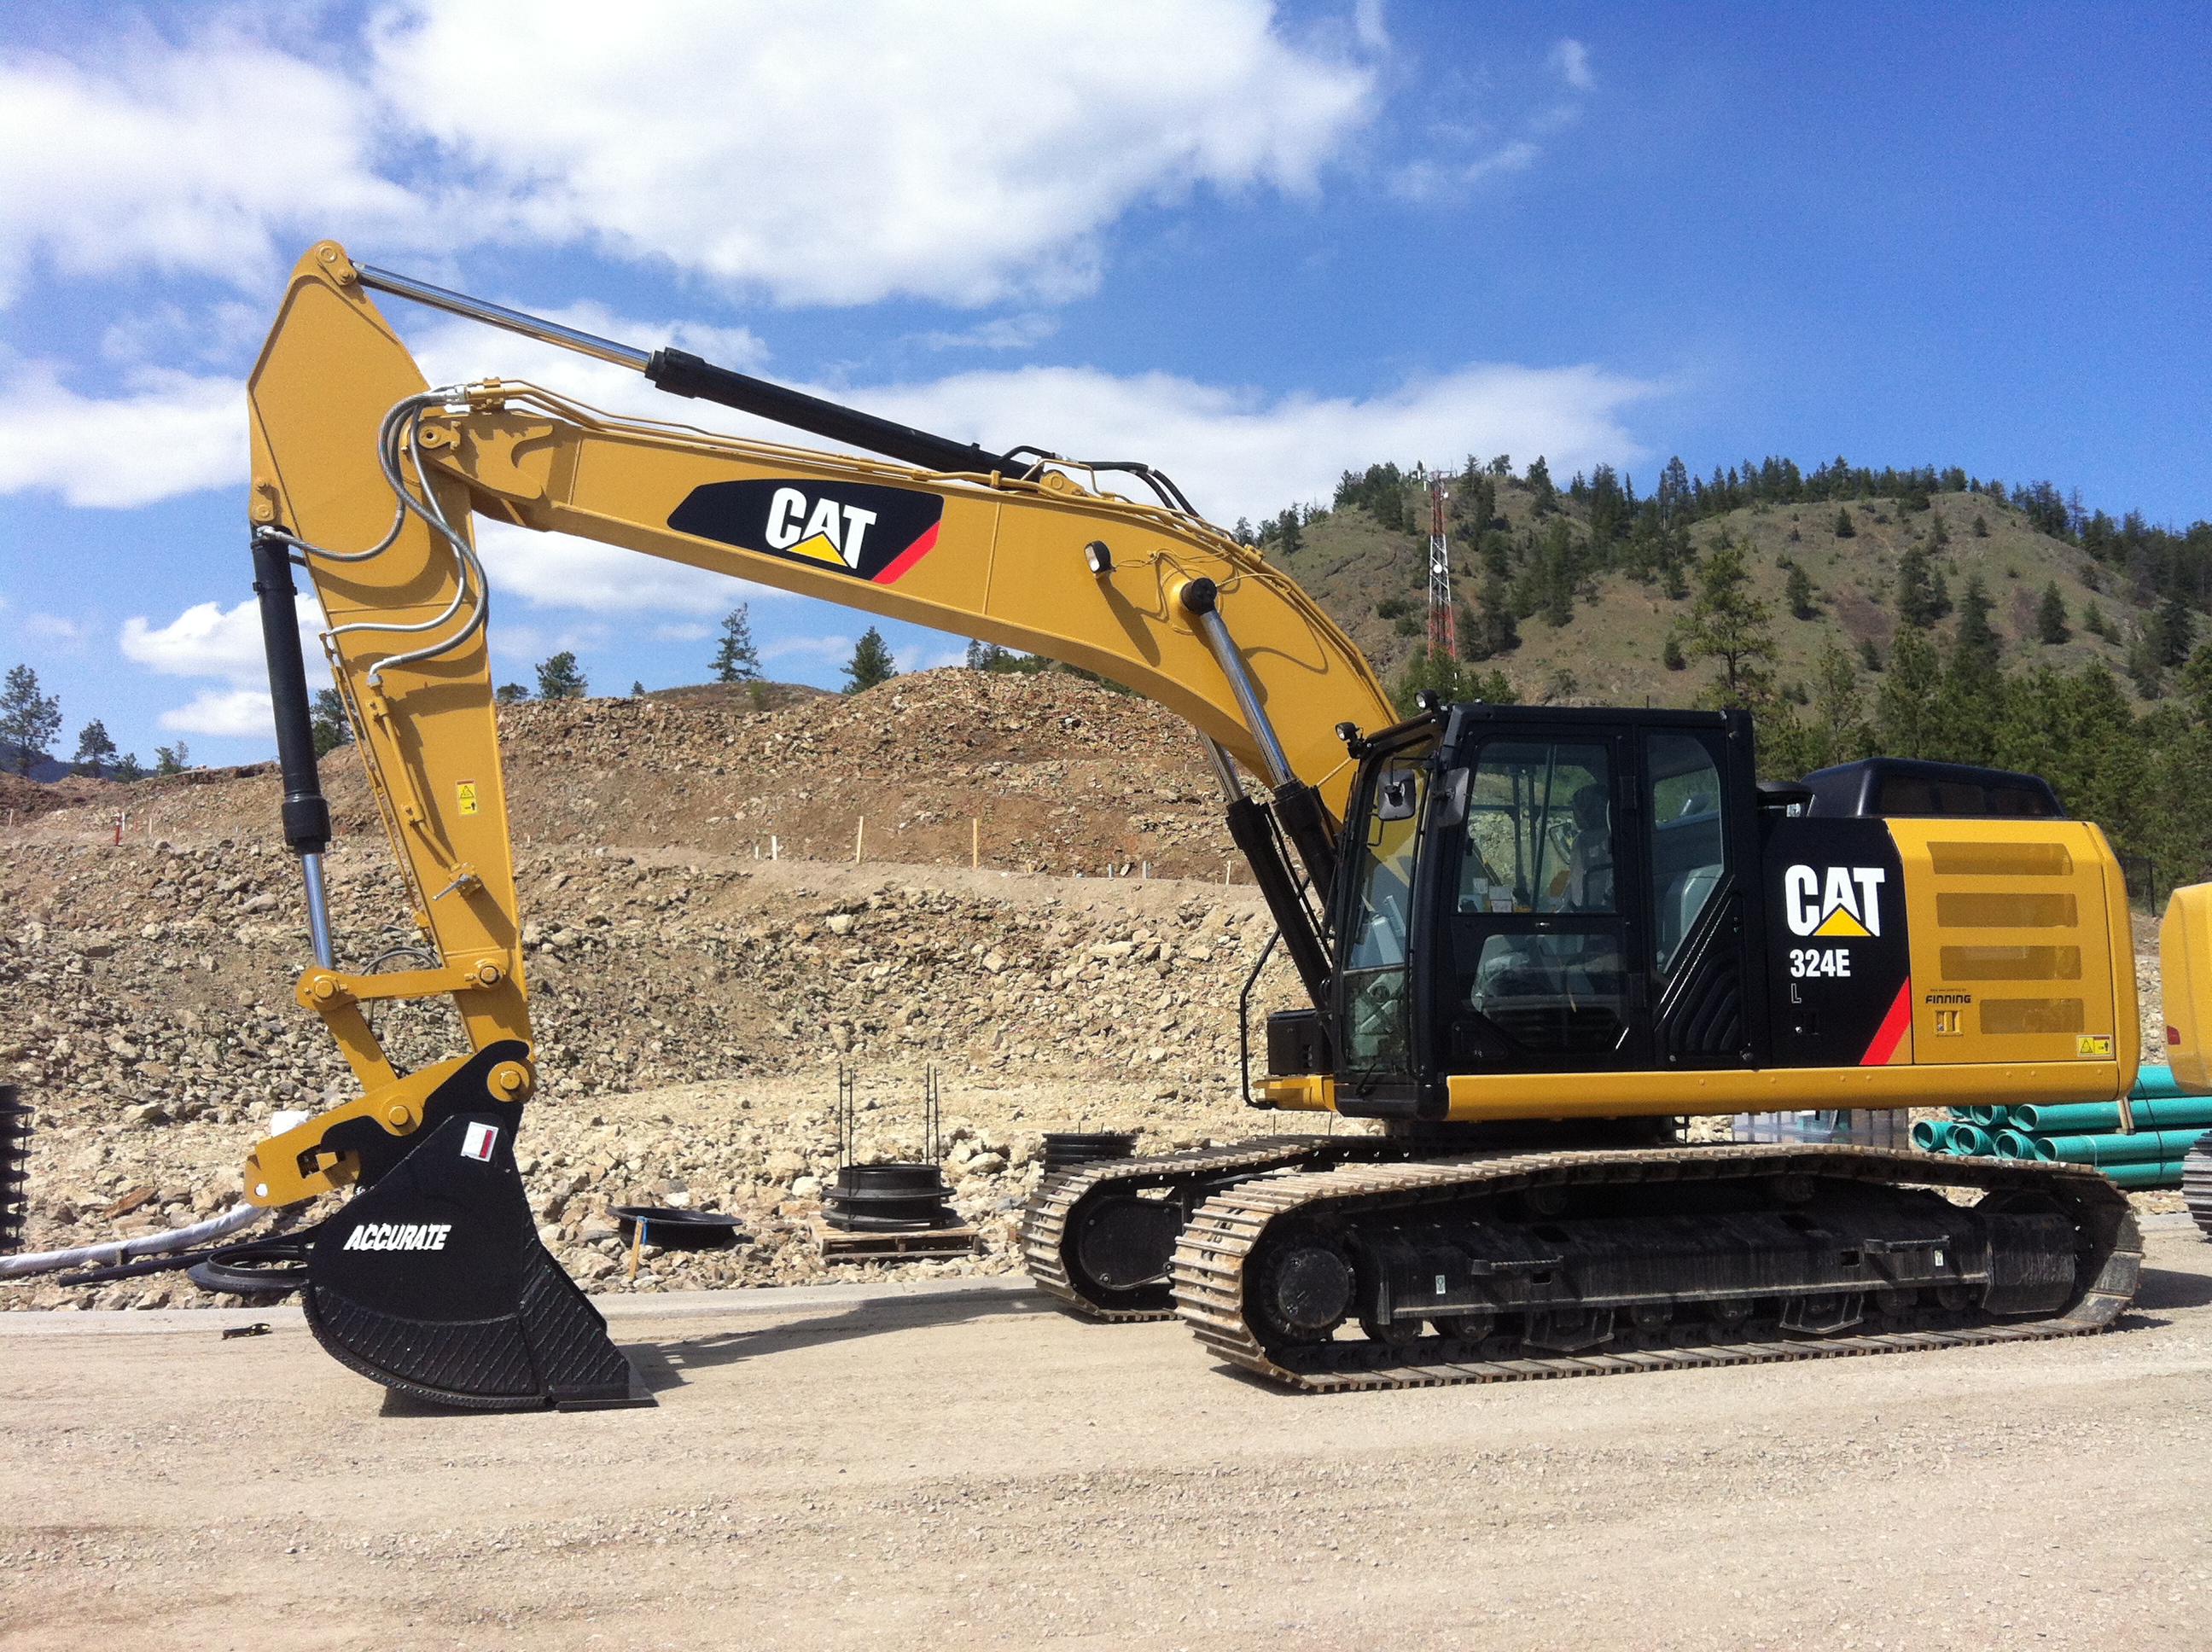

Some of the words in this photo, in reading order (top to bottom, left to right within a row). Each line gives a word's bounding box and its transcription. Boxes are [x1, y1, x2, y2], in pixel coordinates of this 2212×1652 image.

[765, 487, 877, 569] CAT
[1784, 864, 1885, 937] CAT
[1790, 949, 1851, 978] 324E
[1790, 983, 1802, 1003] L
[1925, 994, 1971, 1003] FINNING
[343, 1223, 451, 1251] ACCURATE
